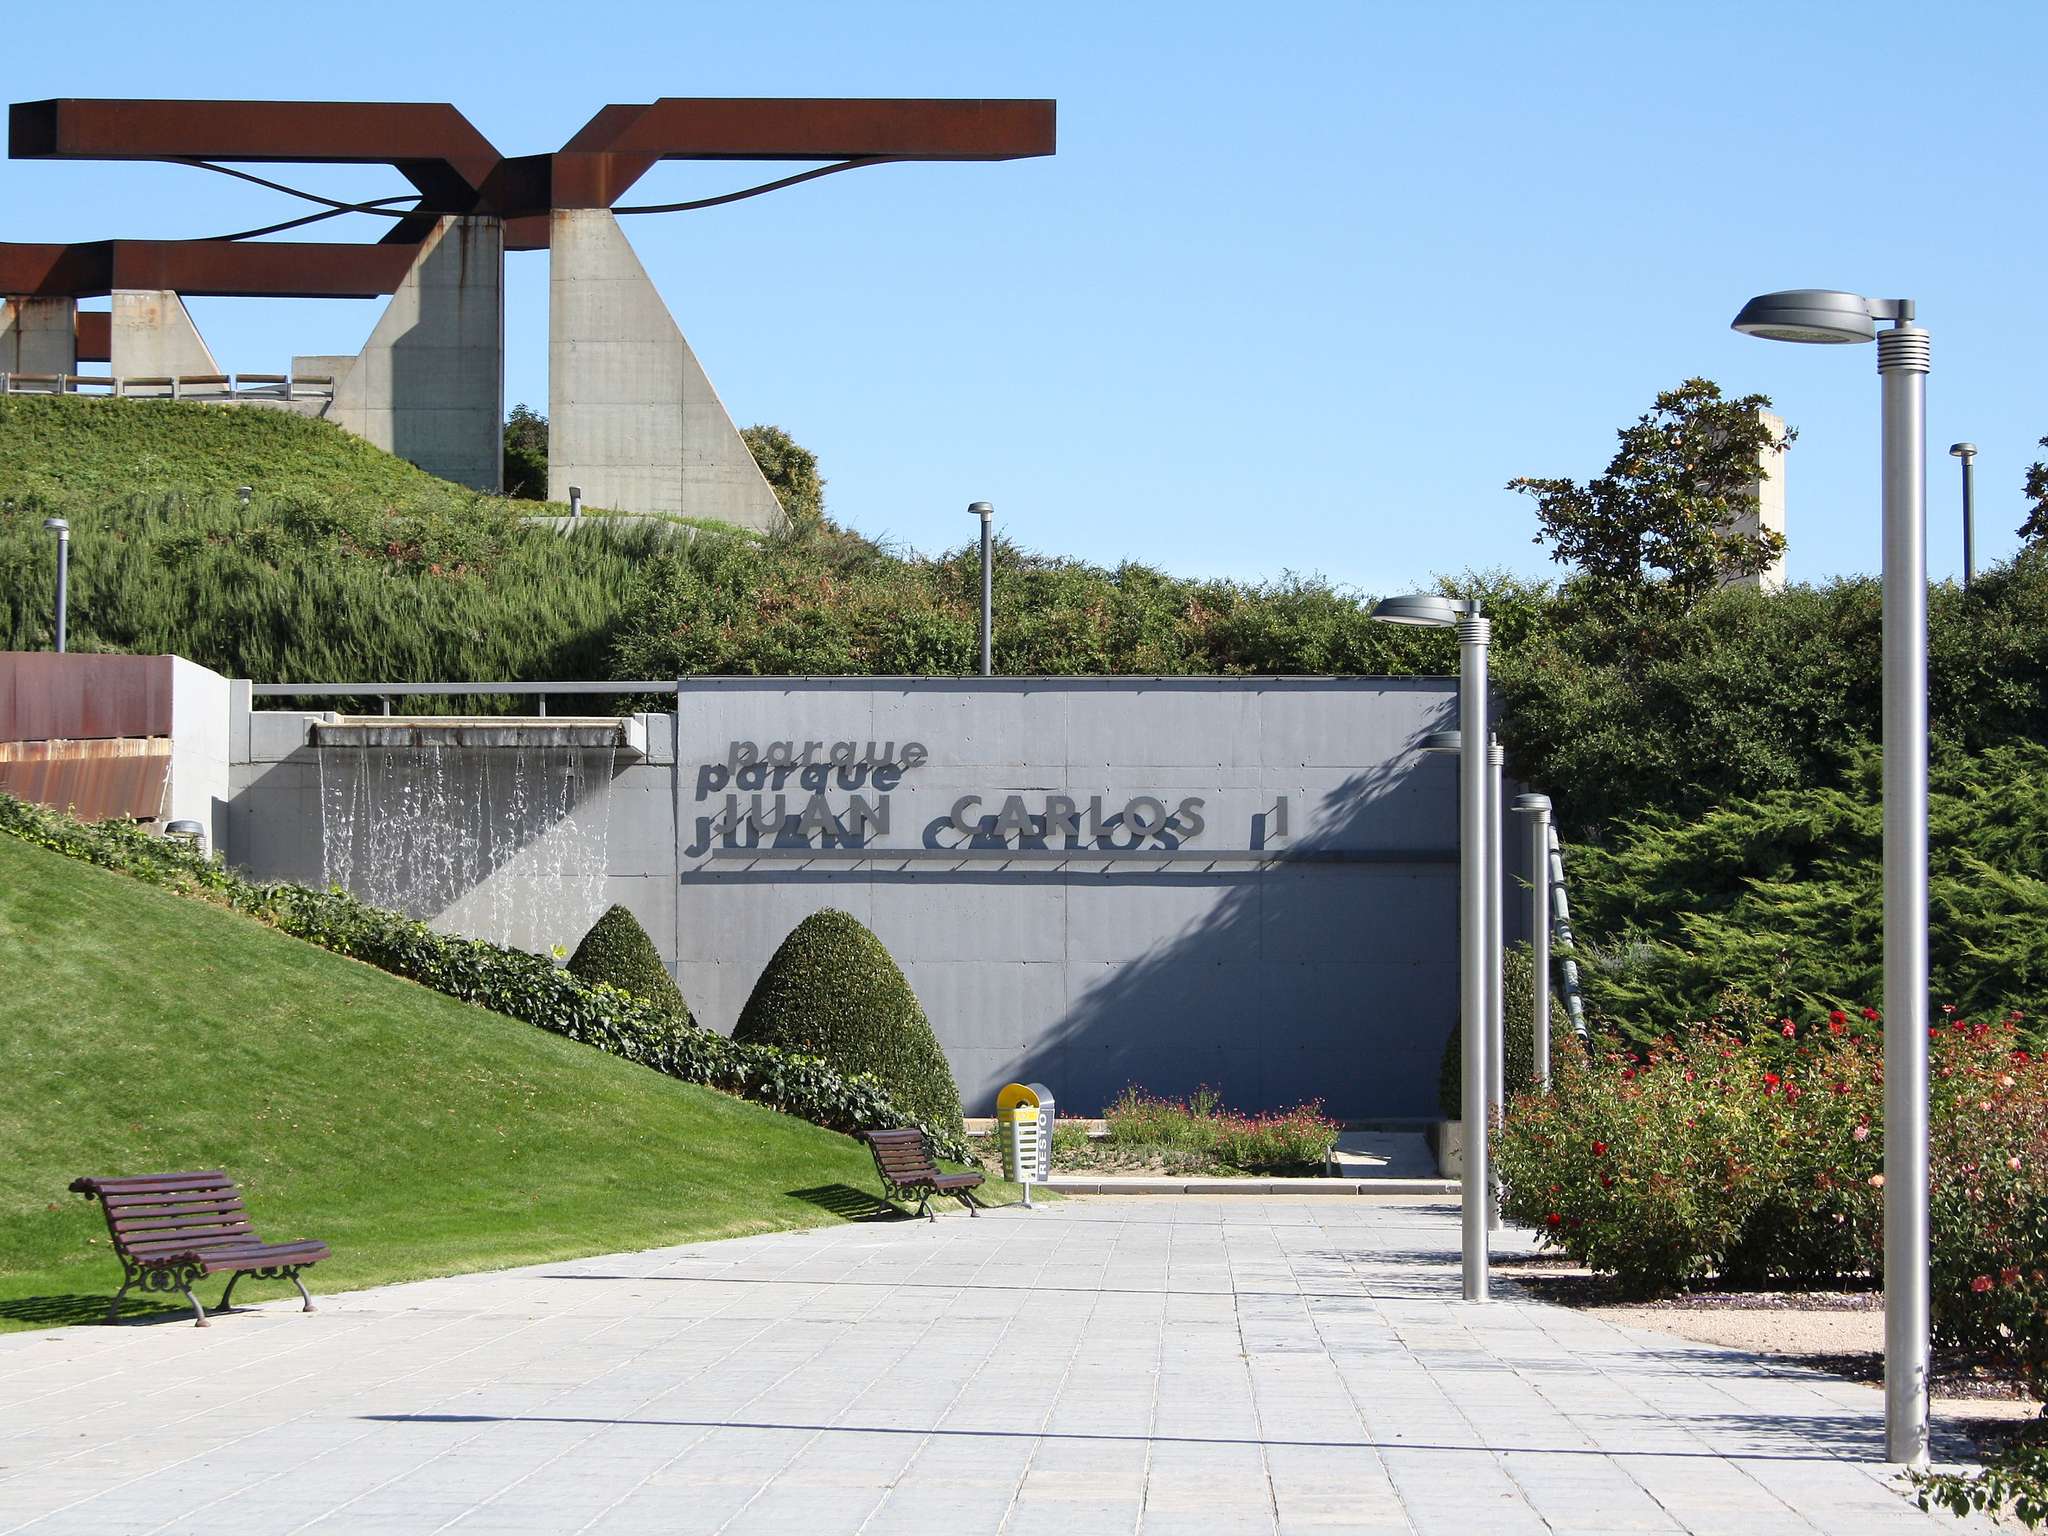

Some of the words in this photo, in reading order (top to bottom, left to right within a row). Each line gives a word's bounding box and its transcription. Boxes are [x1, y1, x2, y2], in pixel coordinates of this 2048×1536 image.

[727, 741, 929, 776] parque
[712, 794, 890, 836] JUAN
[950, 794, 1206, 838] CARLOS
[1276, 795, 1289, 837] I
[1038, 1113, 1047, 1175] RESTO
